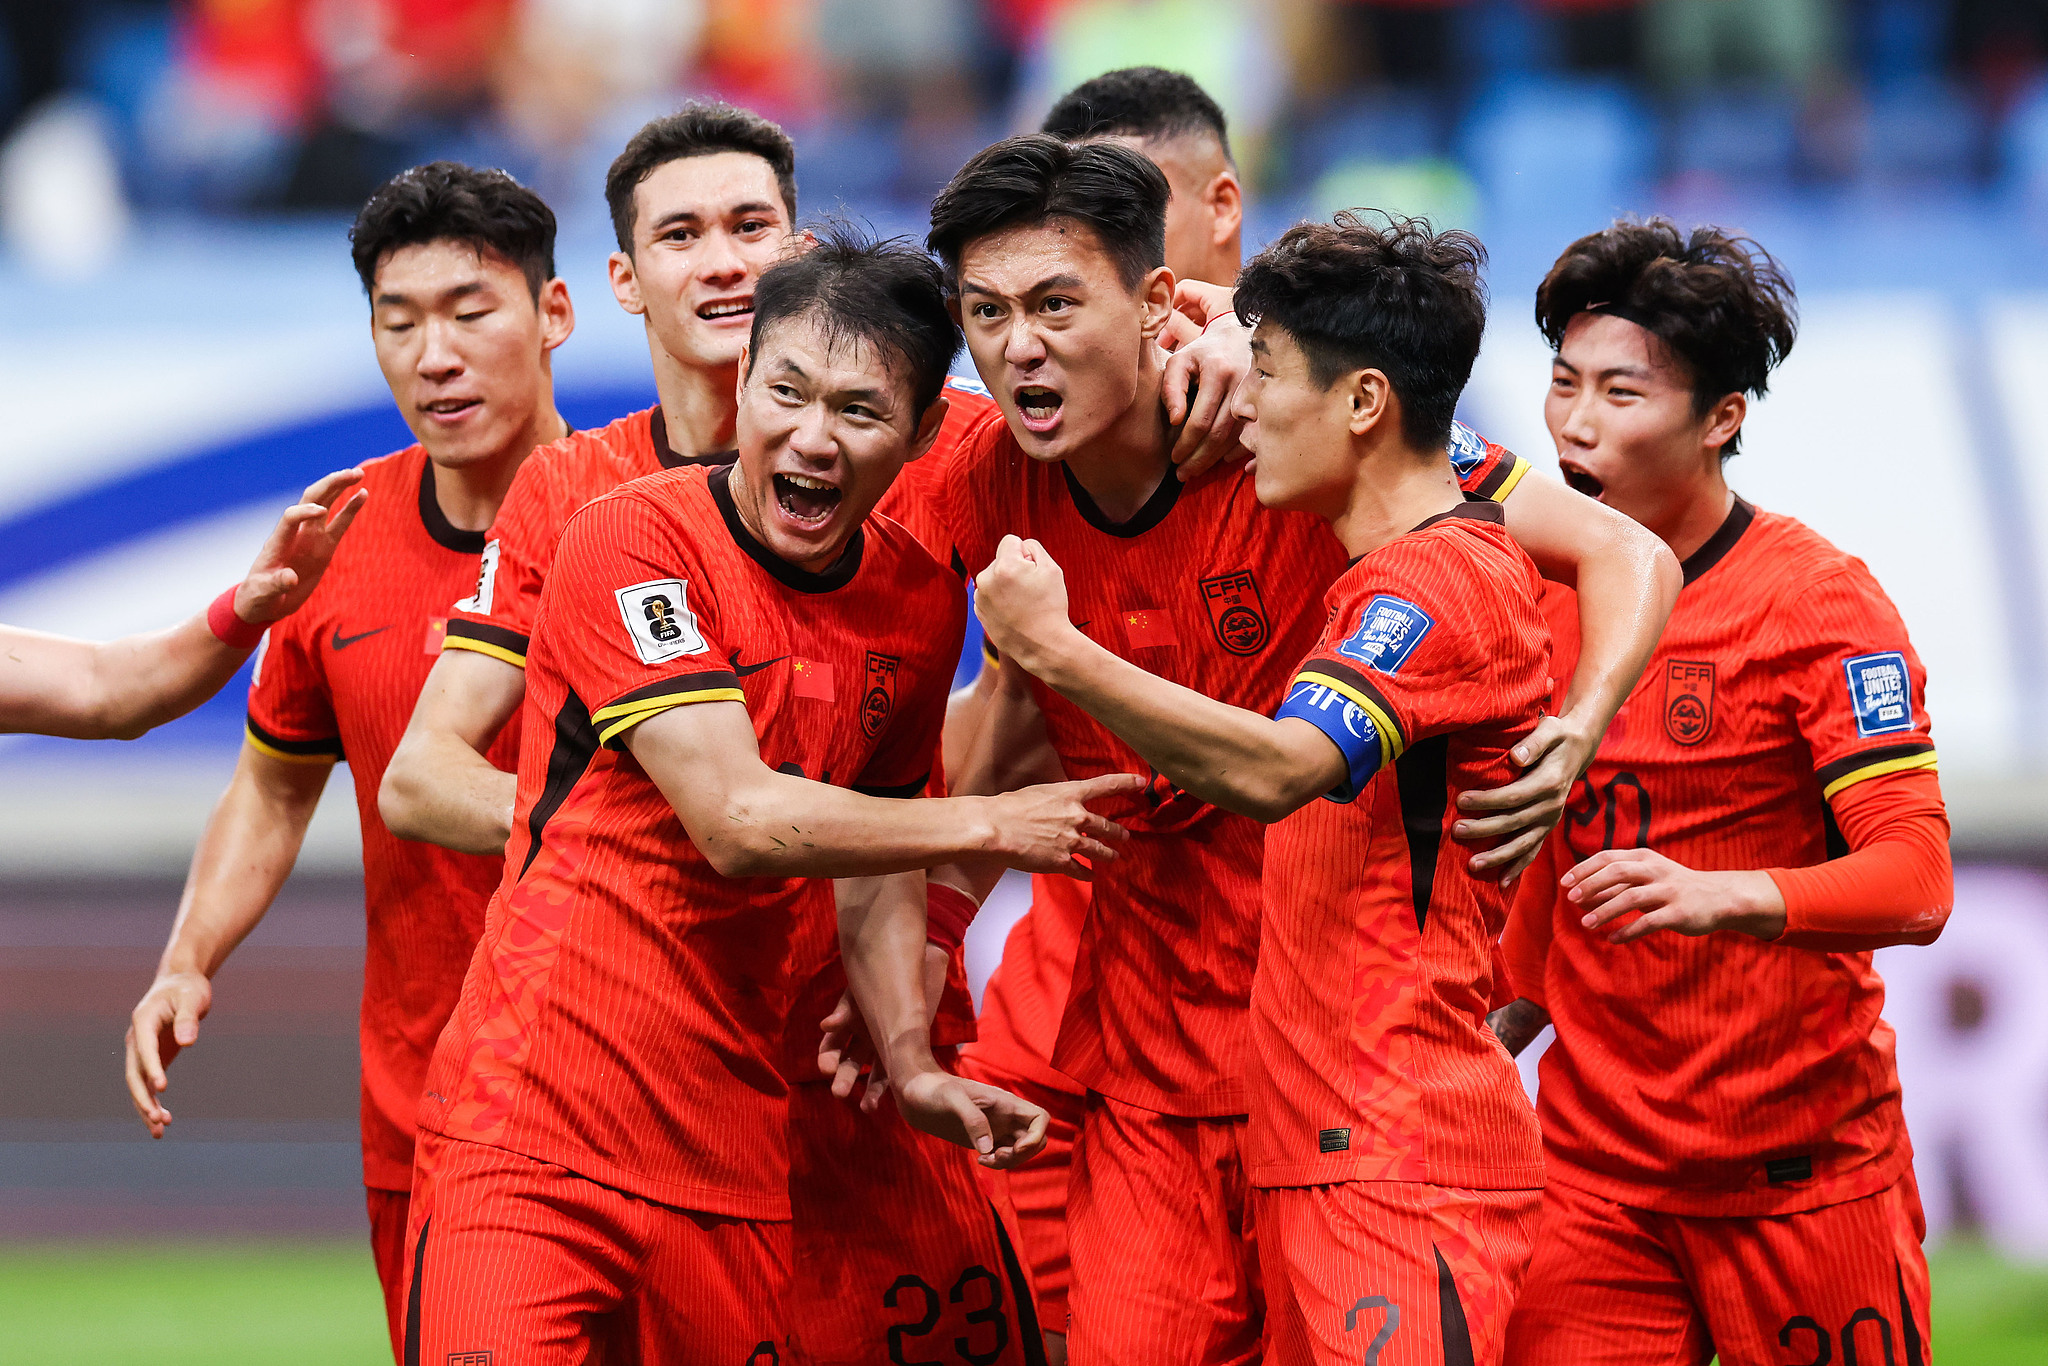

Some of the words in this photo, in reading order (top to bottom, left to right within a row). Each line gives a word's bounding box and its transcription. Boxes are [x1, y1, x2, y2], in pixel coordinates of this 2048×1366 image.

[1205, 576, 1251, 599] CFA
[1370, 616, 1409, 641] UNITES
[1376, 606, 1414, 630] FOOTBALL
[660, 630, 676, 639] FIFA
[869, 657, 895, 677] CFA
[1672, 665, 1710, 682] CFA
[883, 1265, 1009, 1366] 23
[452, 1355, 487, 1366] CFA
